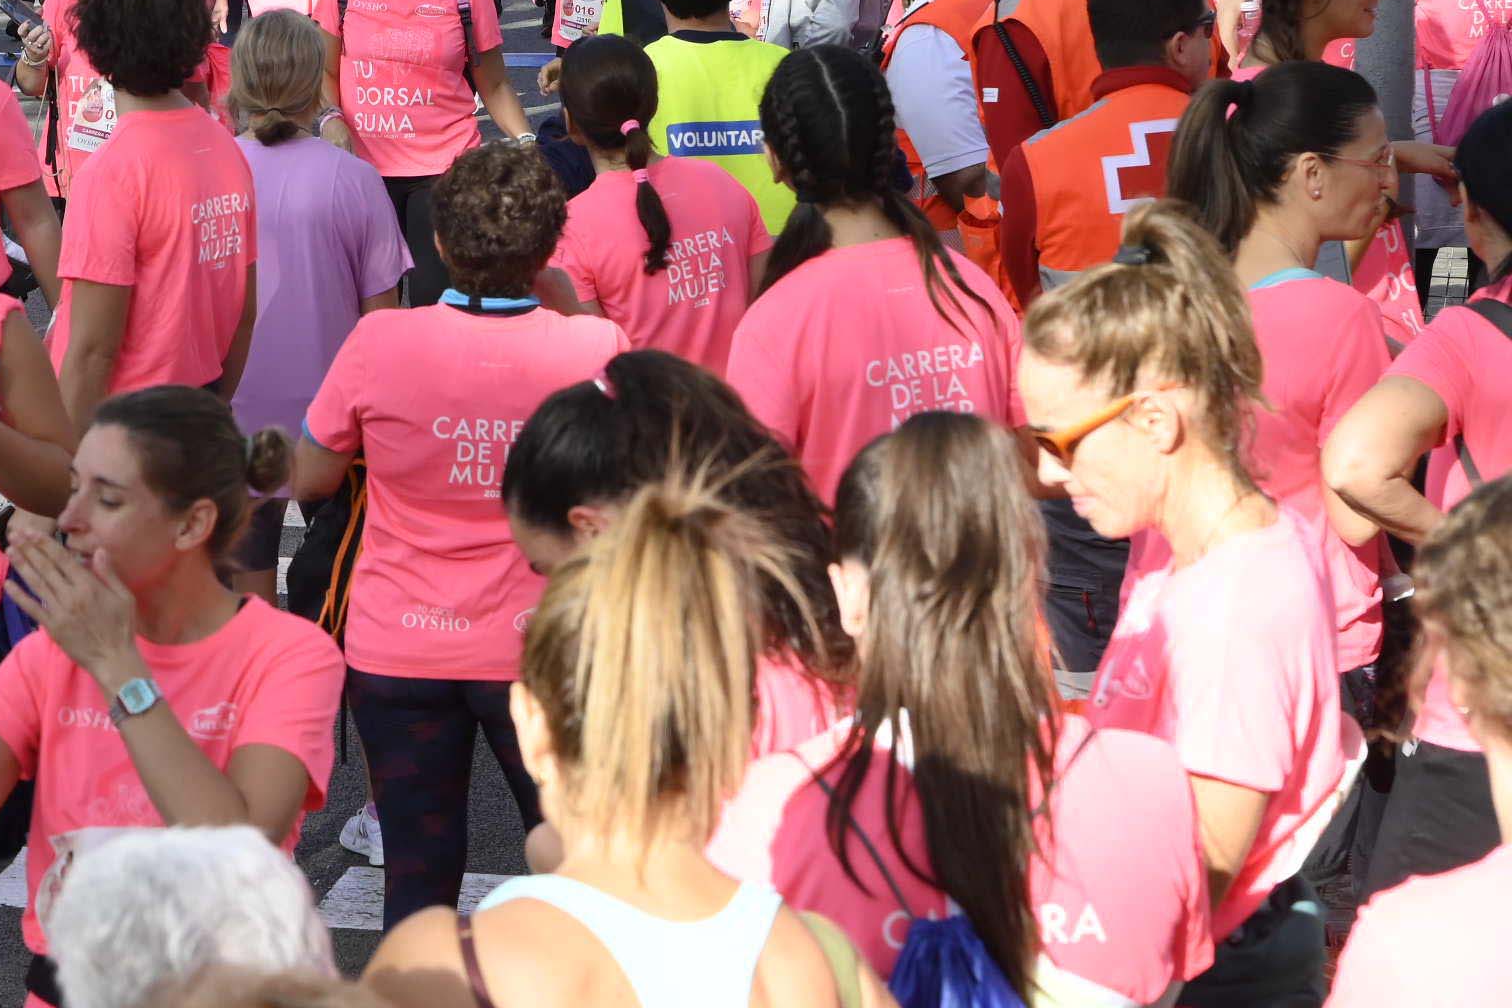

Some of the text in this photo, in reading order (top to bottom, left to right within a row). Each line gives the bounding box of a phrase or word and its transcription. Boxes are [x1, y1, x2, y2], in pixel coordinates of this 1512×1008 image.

[575, 4, 595, 16] 016
[352, 60, 374, 79] TU
[356, 86, 435, 106] DORSAL
[354, 112, 414, 132] SUMA
[670, 129, 766, 149] VOLUNTAR
[191, 193, 250, 225] CARRERA
[201, 216, 240, 242] DE LA
[199, 236, 242, 265] MUJER
[663, 226, 734, 263] ARRERA
[667, 251, 723, 285] DE LA
[668, 270, 728, 306] MUJER
[866, 341, 985, 387] CARRERA
[890, 373, 968, 410] DE LA
[432, 416, 525, 442] CARRE
[455, 441, 492, 464] DE
[483, 489, 502, 498] 202
[401, 612, 471, 633] OYSHO
